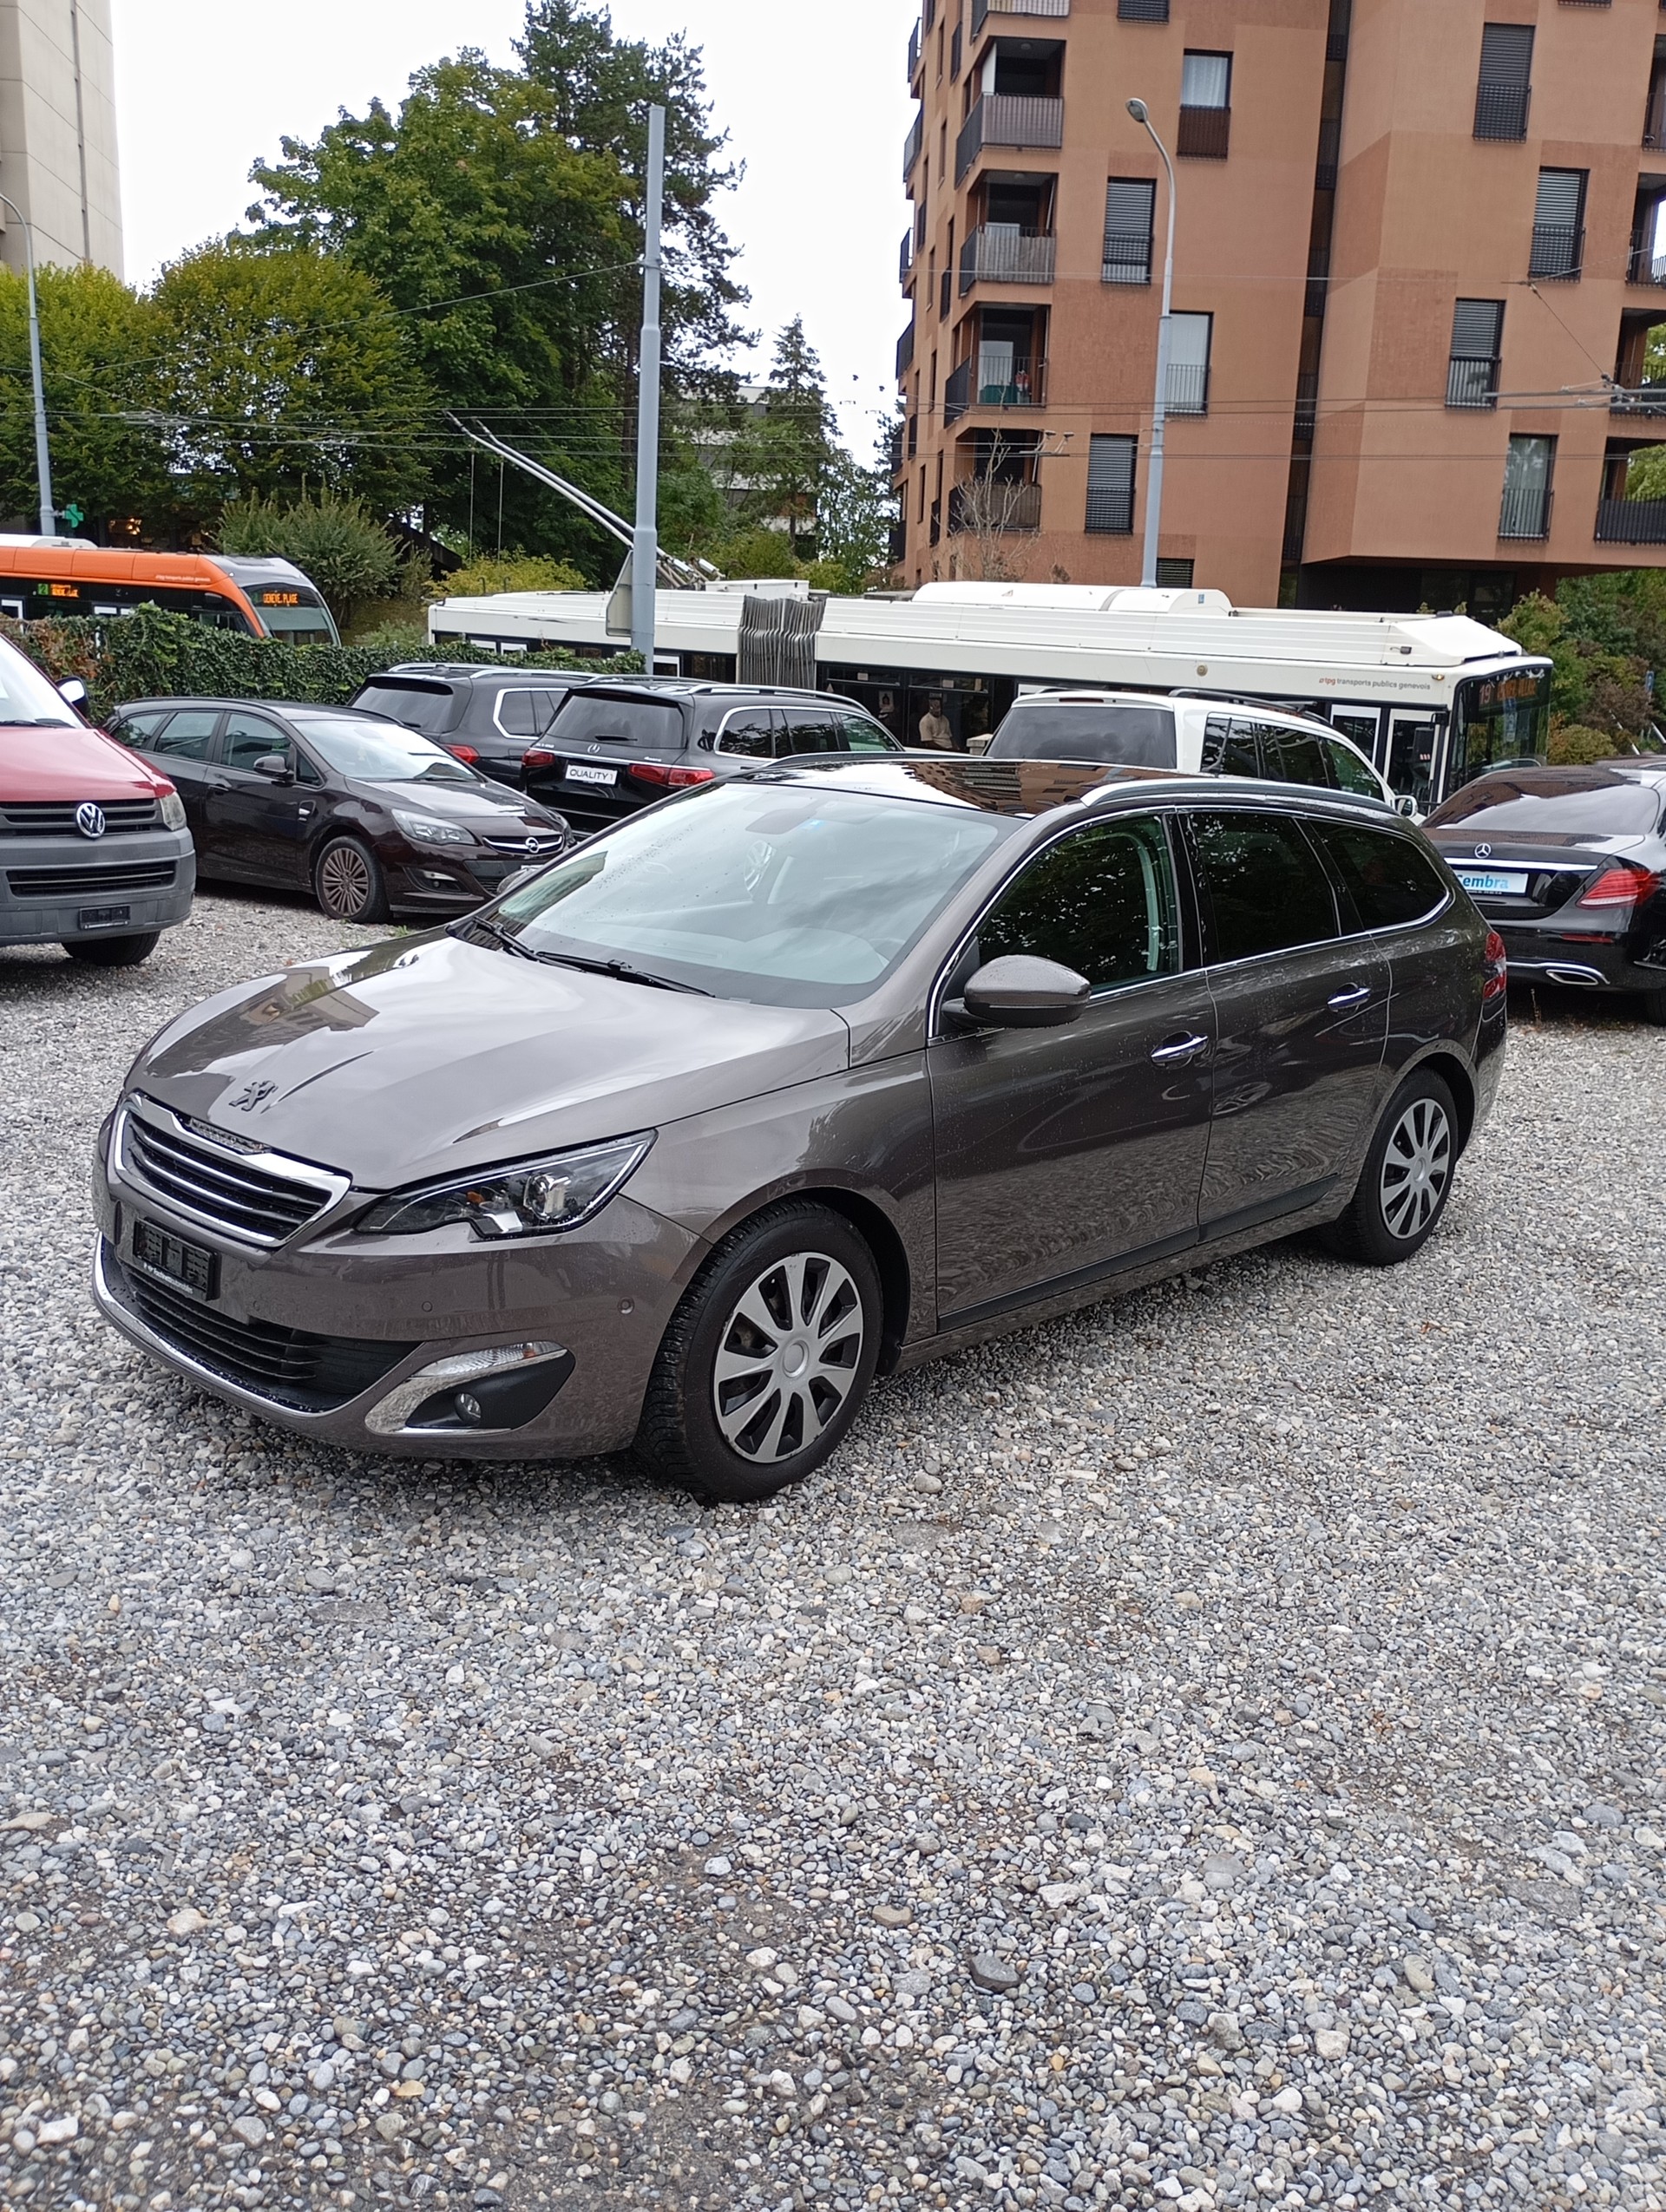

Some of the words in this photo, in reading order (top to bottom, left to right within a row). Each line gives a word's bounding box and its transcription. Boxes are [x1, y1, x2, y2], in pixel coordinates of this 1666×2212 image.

[1325, 677, 1336, 686] tpg
[1337, 677, 1371, 686] transports
[1399, 682, 1431, 690] genevois
[1479, 684, 1492, 704] 19
[569, 769, 608, 780] QUALITY
